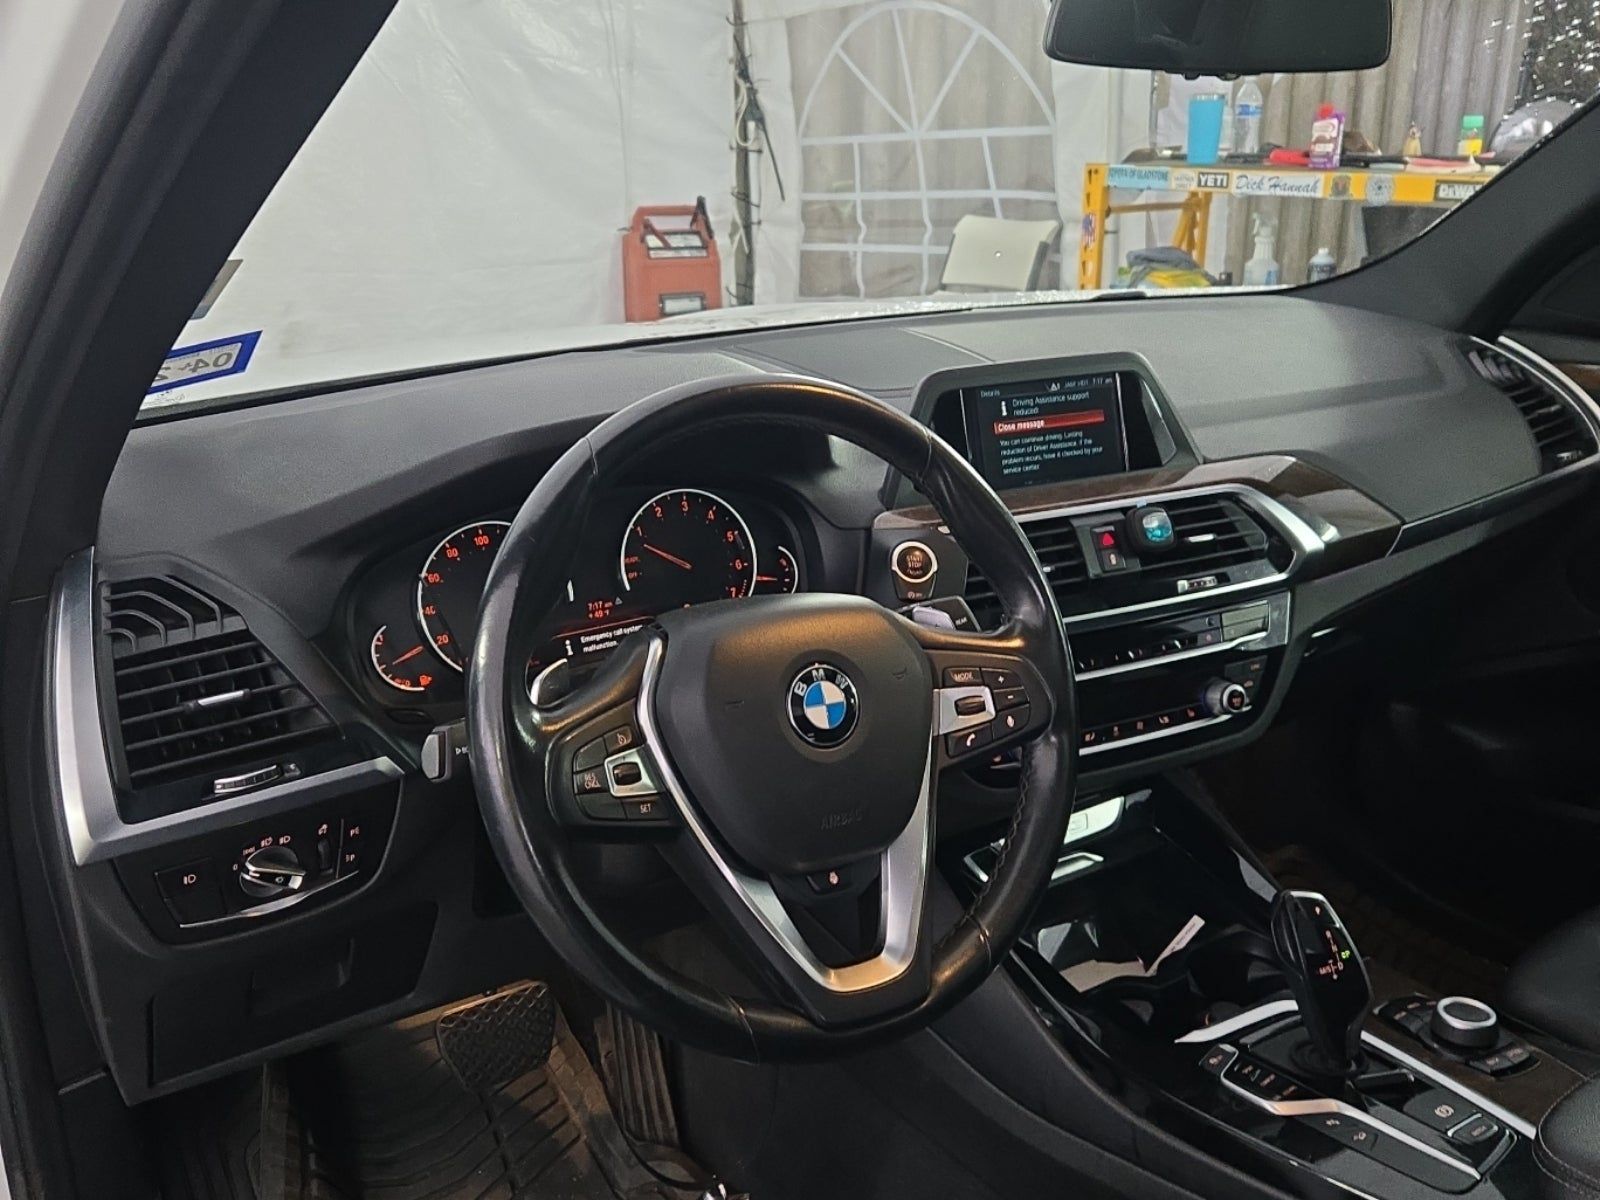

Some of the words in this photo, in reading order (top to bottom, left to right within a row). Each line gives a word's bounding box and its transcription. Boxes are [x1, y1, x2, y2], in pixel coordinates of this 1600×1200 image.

[1199, 174, 1227, 188] YETI
[1236, 174, 1264, 190] Dick
[1268, 176, 1320, 193] Hannah
[1012, 398, 1034, 407] Driving
[1035, 395, 1066, 404] Assistance
[1067, 392, 1089, 401] support
[998, 423, 1016, 432] Close
[1017, 420, 1044, 431] message
[1000, 448, 1026, 456] reduction
[1003, 466, 1022, 475] service
[682, 501, 688, 512] 3
[655, 507, 662, 517] 2
[708, 510, 714, 520] 4
[637, 527, 642, 537] 1
[727, 532, 734, 542] 5
[474, 535, 489, 546] 100
[446, 548, 459, 558] 80
[735, 560, 742, 570] 6
[428, 573, 441, 583] 60
[731, 587, 736, 598] 7
[425, 605, 436, 615] 40
[588, 601, 603, 611] 7:17
[437, 634, 449, 644] 20
[580, 631, 613, 643] Emergency
[613, 628, 623, 636] call
[953, 672, 974, 681] MODE
[794, 668, 849, 698] BMW
[640, 803, 651, 813] SET
